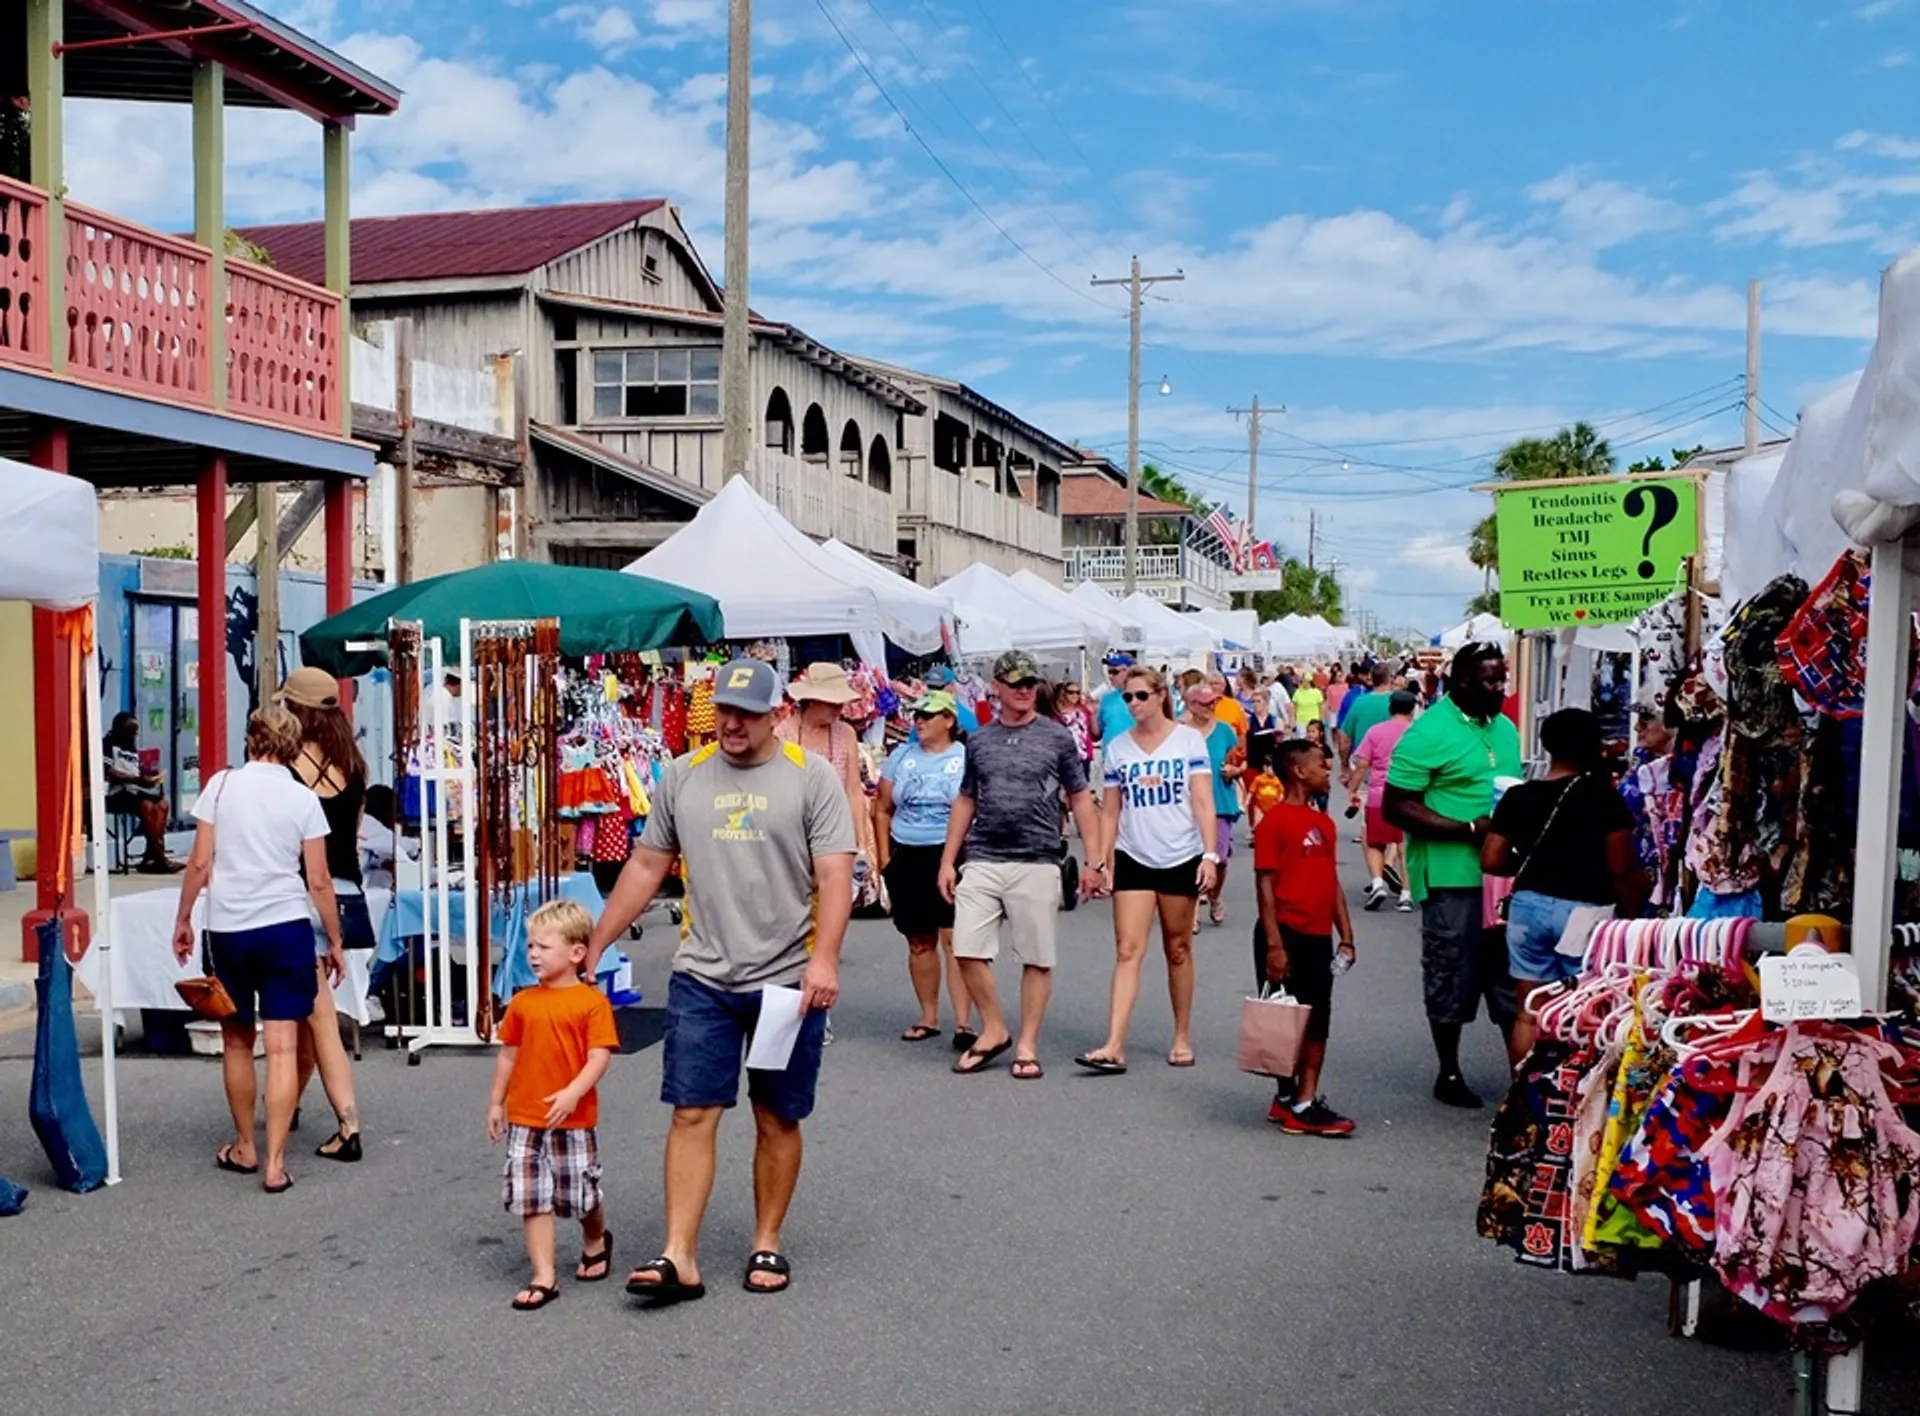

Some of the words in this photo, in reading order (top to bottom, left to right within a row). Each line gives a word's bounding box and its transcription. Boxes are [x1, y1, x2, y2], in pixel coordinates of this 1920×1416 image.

[1528, 491, 1617, 510] Tendonitis
[1533, 509, 1613, 528] Headache
[1556, 530, 1591, 545] TMJ
[1622, 485, 1679, 579] ?
[1551, 549, 1597, 562] Sinus
[1522, 567, 1588, 583] Restless
[1591, 565, 1628, 581] Legs
[1527, 595, 1552, 609] Try
[1556, 596, 1566, 606] a
[1569, 591, 1611, 606] FREE
[1550, 610, 1571, 622] We
[727, 667, 755, 688] C
